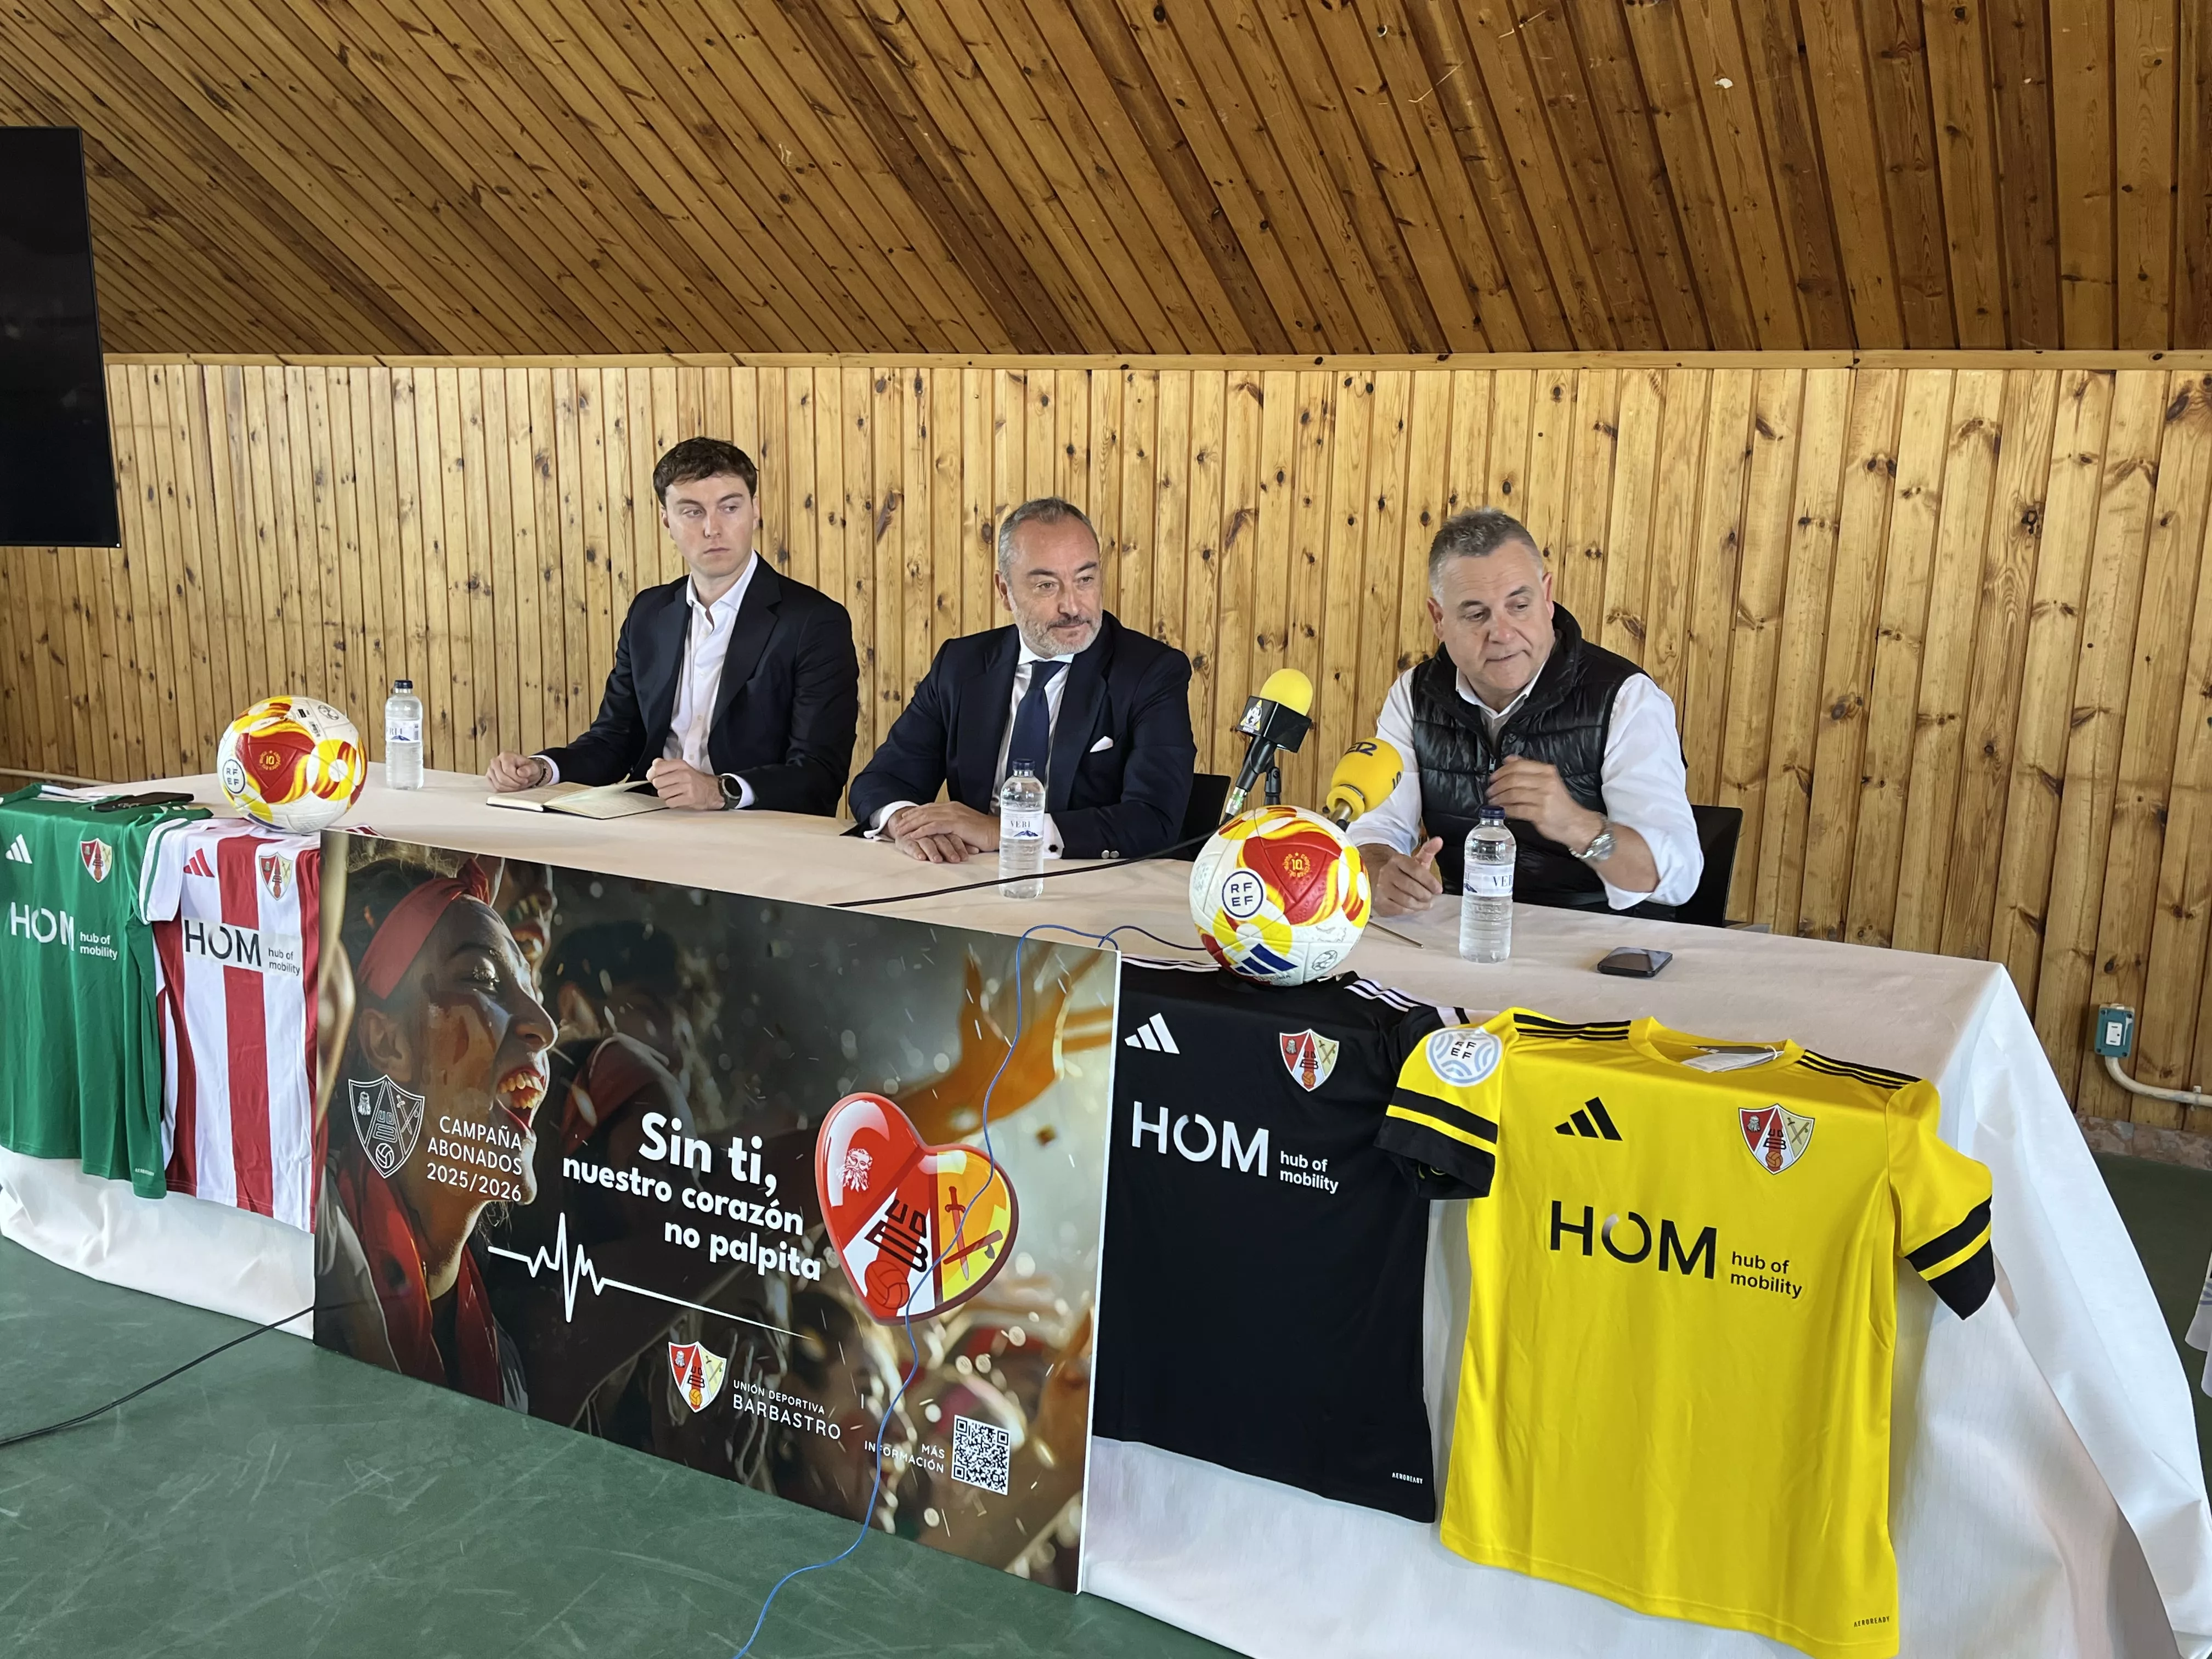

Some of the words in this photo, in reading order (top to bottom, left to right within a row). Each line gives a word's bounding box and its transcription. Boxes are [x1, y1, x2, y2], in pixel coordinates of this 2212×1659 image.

[266, 755, 274, 765] 10
[1291, 859, 1303, 871] 10
[1493, 875, 1513, 887] VER
[10, 901, 74, 951] HOM
[80, 932, 99, 943] hub
[100, 935, 110, 945] of
[184, 919, 261, 967] HOM
[268, 947, 284, 958] hub
[286, 951, 293, 960] of
[80, 946, 117, 961] mobility
[269, 961, 300, 977] mobility
[439, 1116, 522, 1151] CAMPAÑA
[1132, 1101, 1269, 1177] HOM
[1280, 1150, 1308, 1169] hub
[1312, 1159, 1328, 1172] of
[427, 1137, 522, 1175] ABONADOS
[639, 1112, 712, 1173] Sin
[728, 1136, 777, 1197] ti,
[427, 1163, 521, 1202] 2025/2026
[563, 1158, 673, 1202] nuestro
[682, 1188, 803, 1235] corazón
[1280, 1169, 1339, 1194] mobility
[664, 1222, 700, 1249] no
[710, 1232, 821, 1281] palpita
[1550, 1200, 1717, 1280] HOM
[1731, 1251, 1765, 1270] hub
[1771, 1260, 1790, 1274] of
[1730, 1273, 1802, 1300] mobility
[733, 1380, 765, 1396] UNIÓN
[769, 1390, 825, 1415] DEPORTIVA
[733, 1393, 840, 1440] BARBASTRO
[922, 1443, 945, 1459] MÁS
